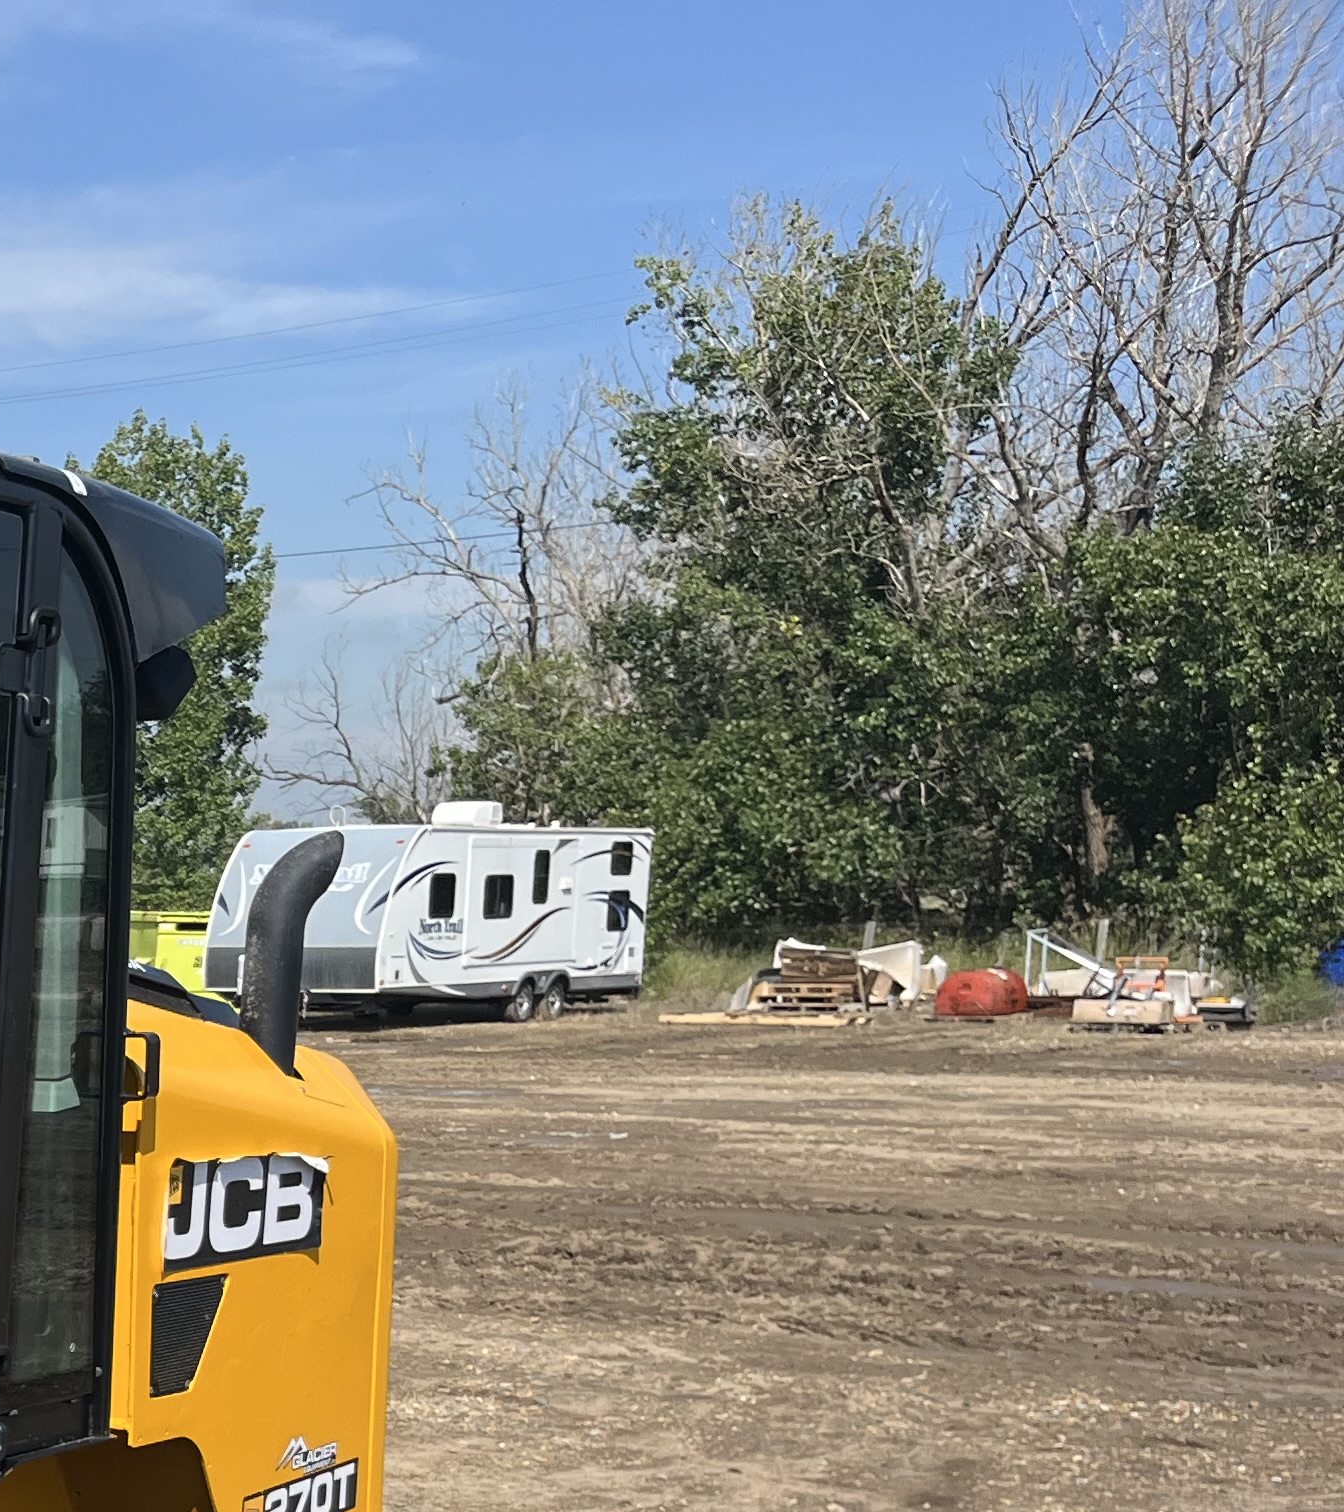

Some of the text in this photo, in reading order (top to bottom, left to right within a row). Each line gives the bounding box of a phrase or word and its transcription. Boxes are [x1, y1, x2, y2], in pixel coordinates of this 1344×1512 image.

[418, 918, 443, 935] North
[164, 1155, 314, 1261] JCB
[292, 1442, 337, 1471] GLACIER
